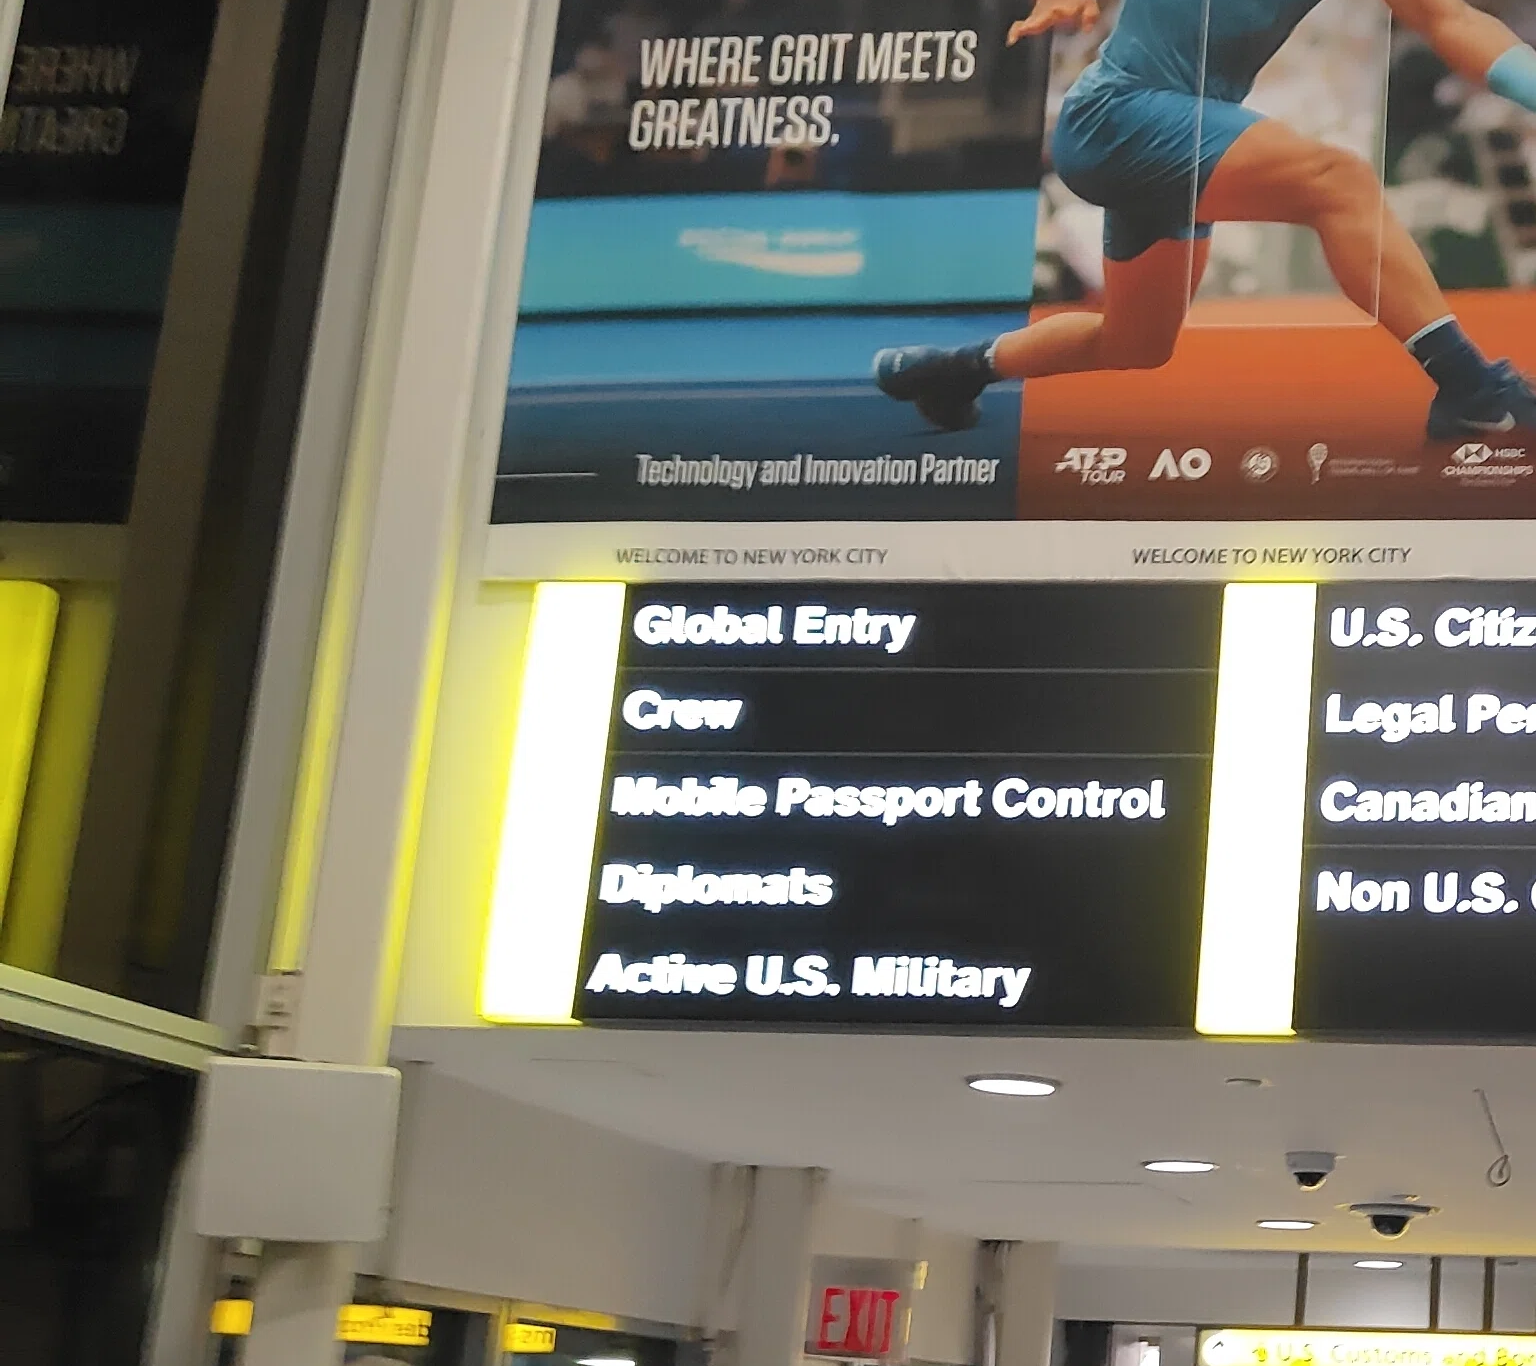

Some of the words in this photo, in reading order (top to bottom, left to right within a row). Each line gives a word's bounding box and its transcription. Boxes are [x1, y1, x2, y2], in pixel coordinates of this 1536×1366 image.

[640, 35, 764, 89] WHERE
[768, 33, 854, 86] GRIT
[856, 30, 979, 84] MEETS
[628, 95, 841, 151] GREATNESS.
[635, 453, 757, 490] Technology
[758, 454, 801, 486] and
[804, 454, 918, 486] Innovation
[920, 453, 1000, 485] Partner
[1055, 447, 1128, 472] ATP
[1494, 447, 1527, 459] HSBC
[1080, 469, 1127, 485] TOUR
[616, 547, 709, 566] WELCOME
[713, 547, 738, 565] TO
[743, 547, 787, 566] NEW
[791, 547, 842, 566] YORK
[846, 547, 890, 566] CITY
[1131, 547, 1228, 566] WELCOME
[1231, 547, 1258, 566] TO
[1262, 547, 1309, 566] NEW
[1311, 546, 1364, 565] YORK
[1368, 546, 1414, 565] CITY
[633, 604, 784, 646] Global
[792, 605, 917, 654] Entry
[1330, 607, 1424, 648] U.S.
[622, 689, 744, 731] Crew
[1325, 693, 1457, 743] Legal
[609, 776, 768, 817] Mobile
[774, 777, 984, 827] Passport
[991, 777, 1166, 819] Control
[598, 863, 834, 914] Diplomats
[1316, 870, 1411, 912] Non
[1423, 871, 1519, 914] U.S.
[584, 953, 738, 995] Active
[745, 954, 841, 997] U.S.
[851, 955, 1032, 1008] Military
[816, 1287, 901, 1354] EXIT
[1276, 1343, 1313, 1363] US
[1442, 1348, 1486, 1366] ad
